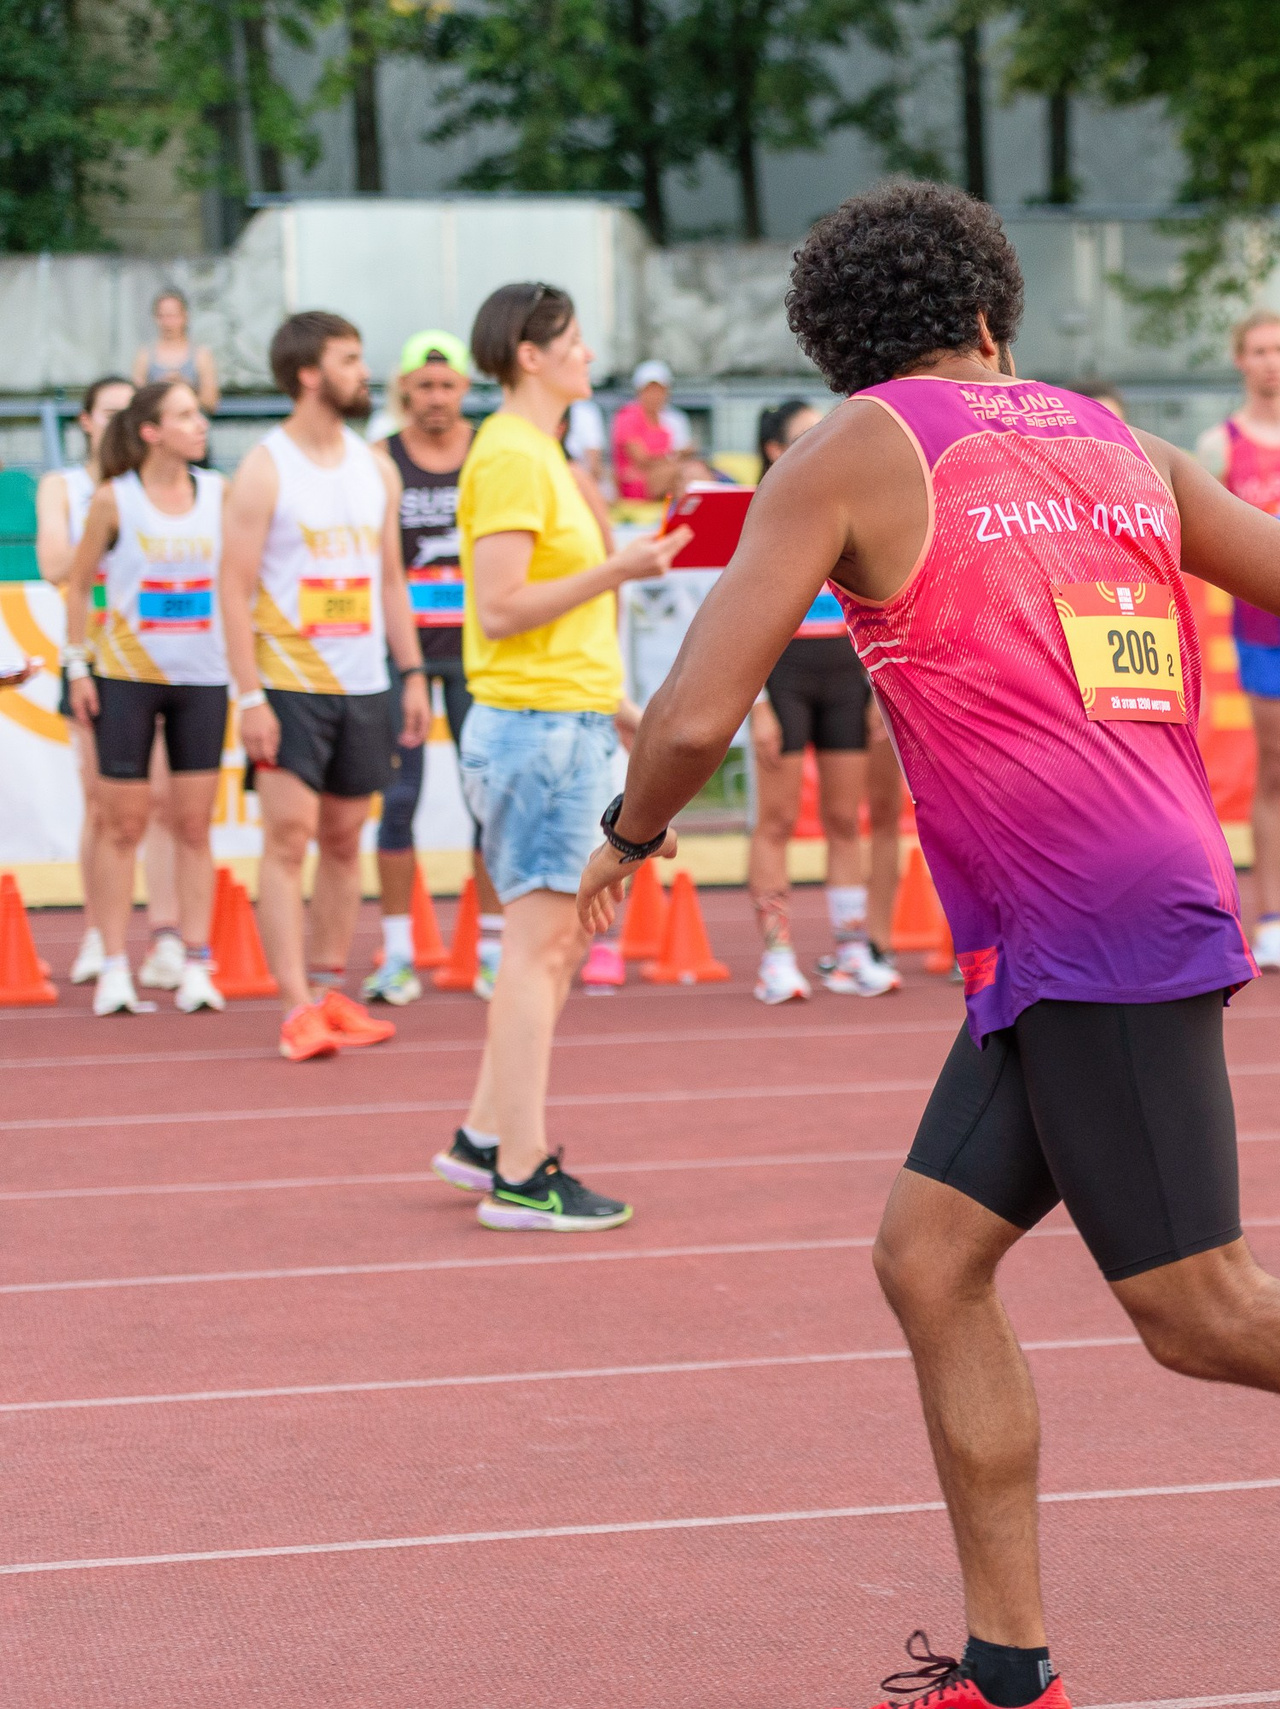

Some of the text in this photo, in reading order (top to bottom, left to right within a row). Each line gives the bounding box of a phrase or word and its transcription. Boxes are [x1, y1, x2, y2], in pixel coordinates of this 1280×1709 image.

[1024, 415, 1078, 428] sleeps
[966, 497, 1077, 543] ZHAN
[1107, 629, 1175, 677] 206 2
